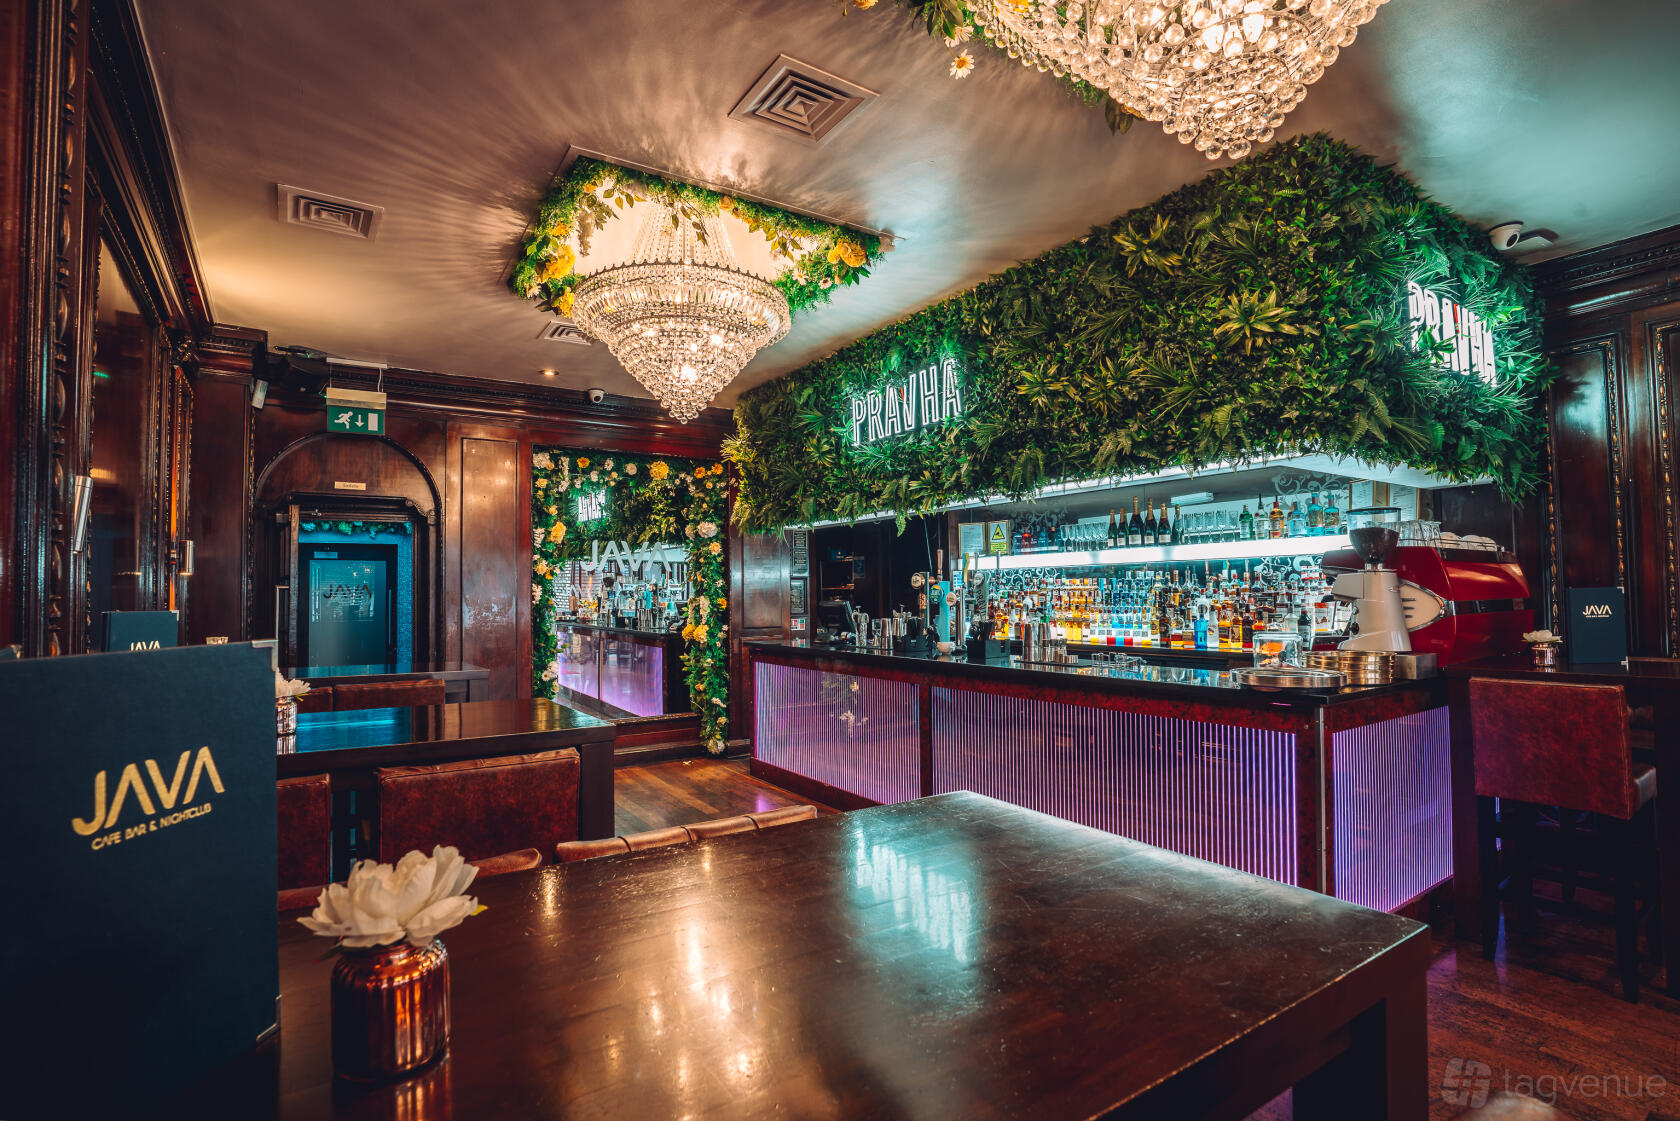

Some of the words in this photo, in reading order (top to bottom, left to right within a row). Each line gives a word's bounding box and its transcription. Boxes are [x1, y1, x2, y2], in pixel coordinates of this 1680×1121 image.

[852, 359, 962, 446] PRAVHA
[580, 539, 672, 572] JAVA
[323, 584, 372, 599] JAVA
[1582, 605, 1612, 615] JAVA
[72, 745, 225, 836] JAVA
[91, 831, 122, 850] CAFE
[125, 823, 147, 840] BAR
[149, 820, 158, 832] &
[160, 802, 212, 828] NIGHTCLUB
